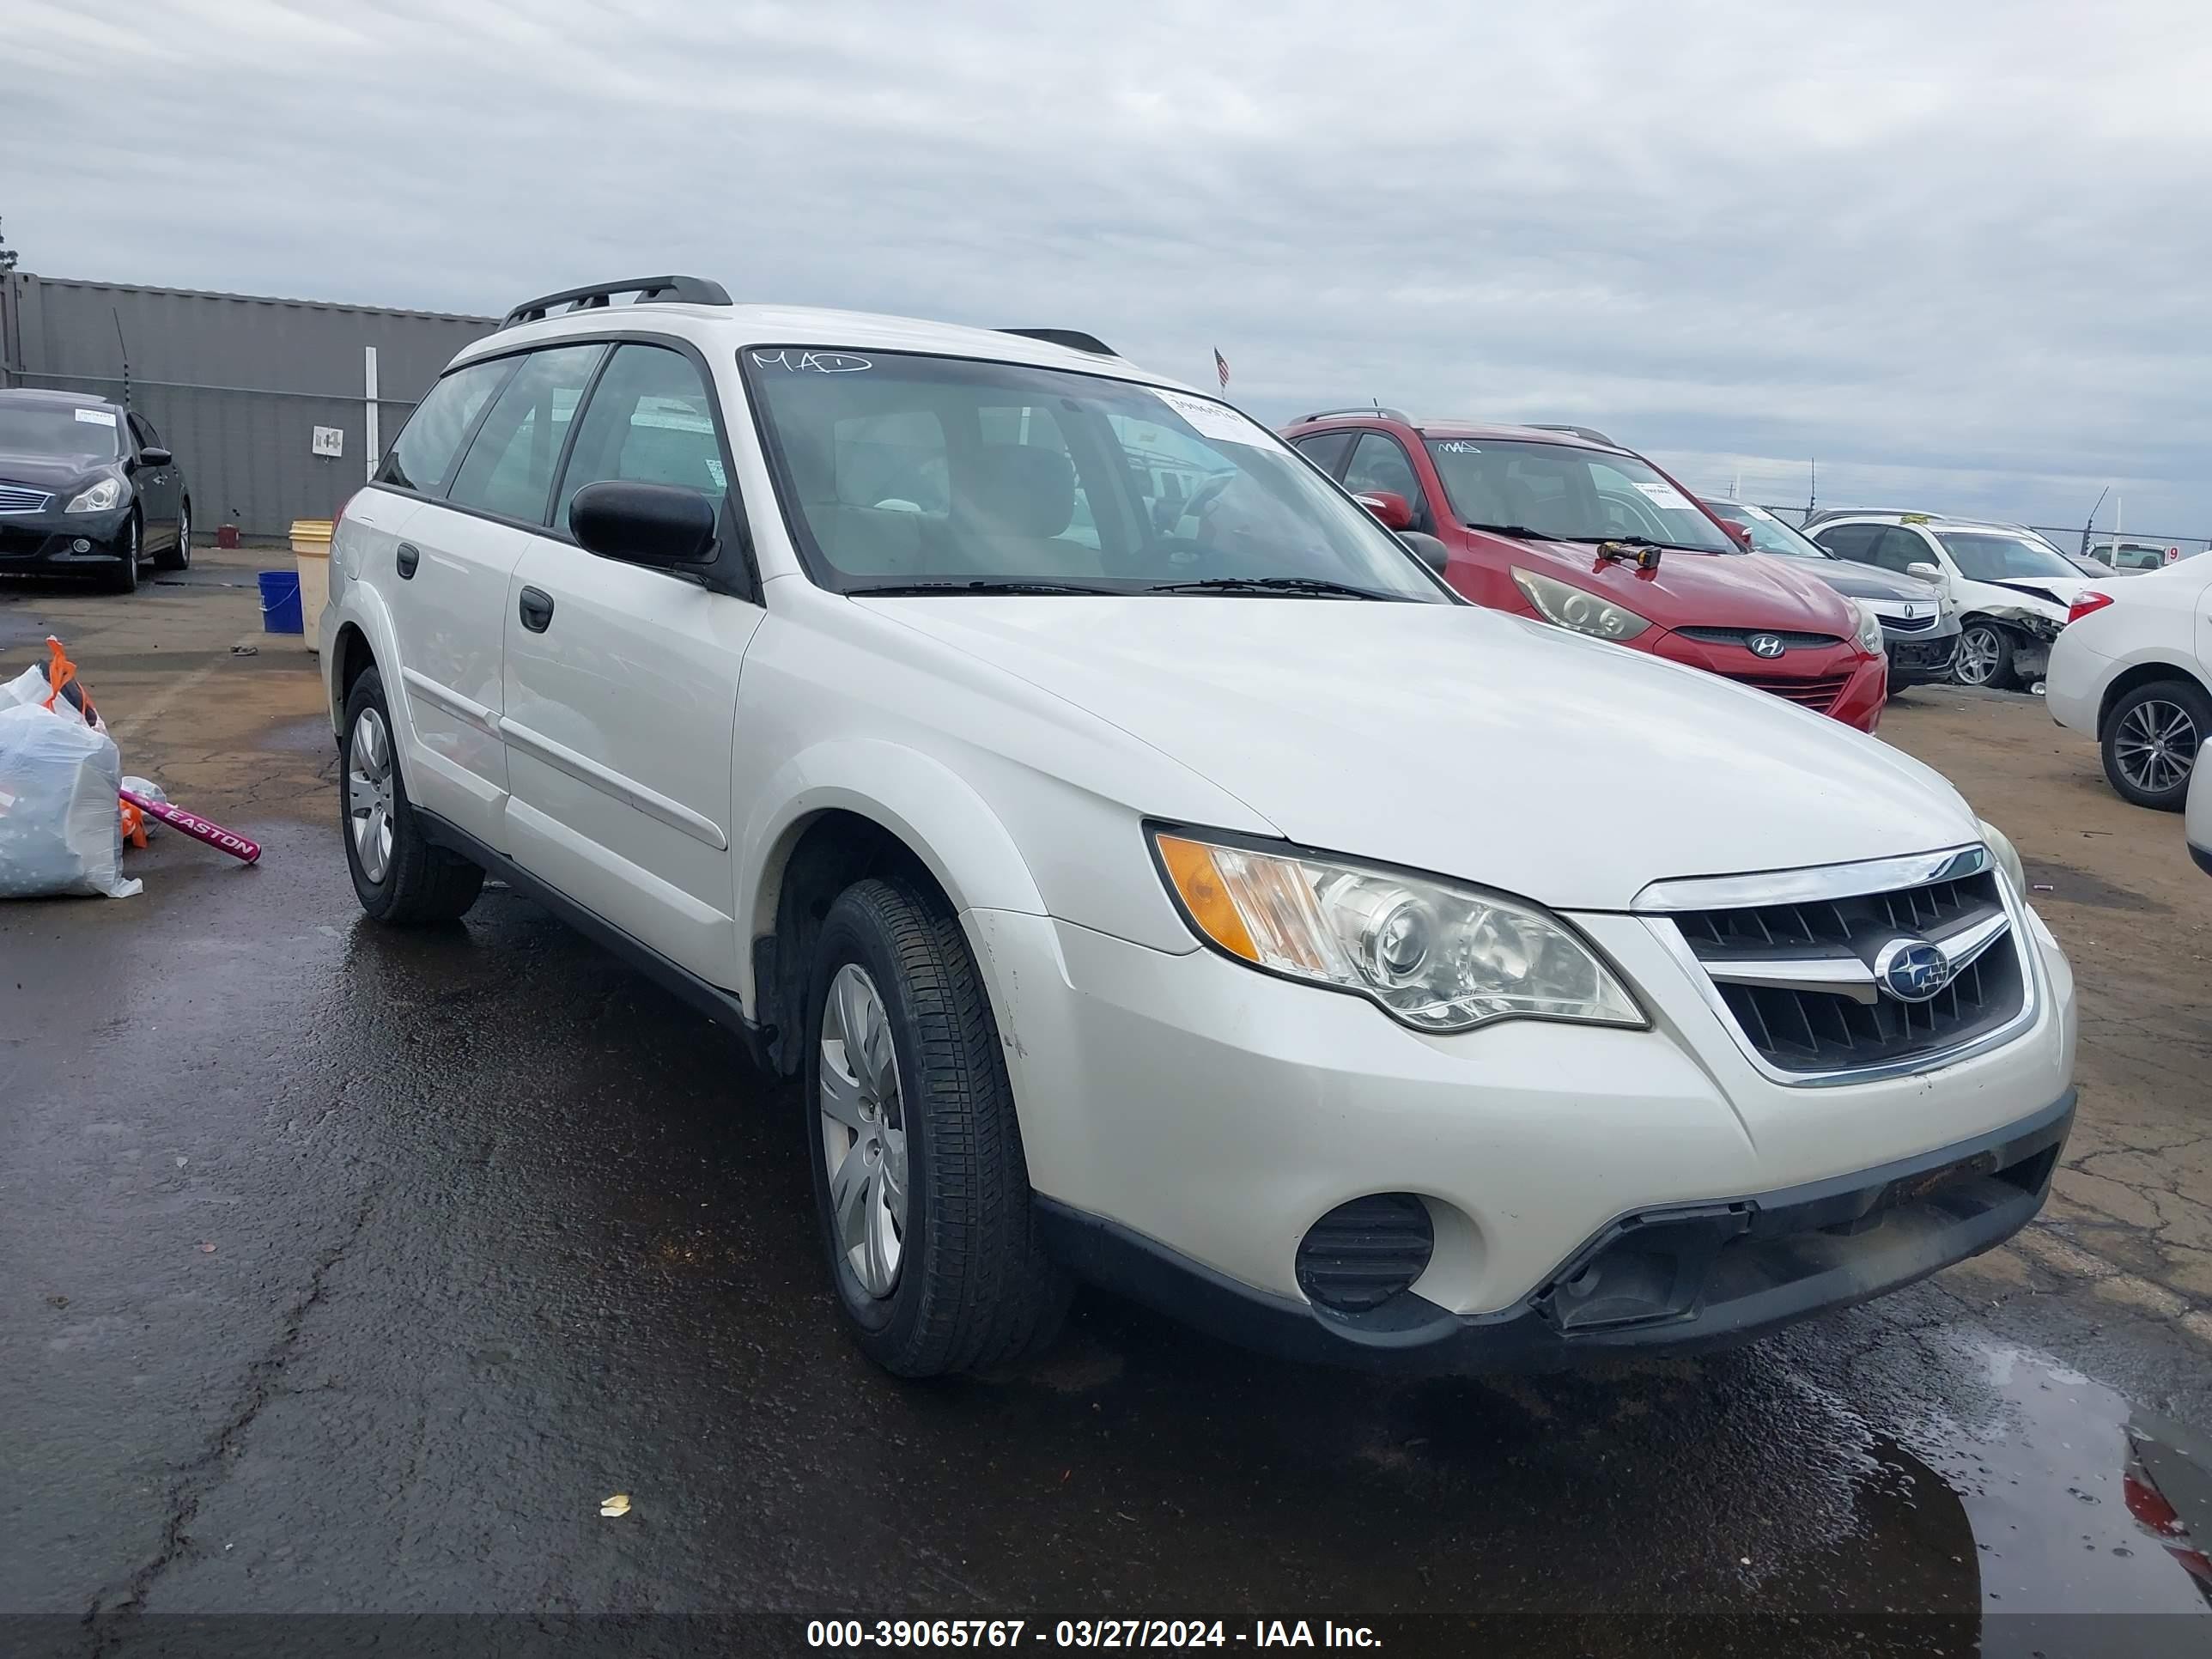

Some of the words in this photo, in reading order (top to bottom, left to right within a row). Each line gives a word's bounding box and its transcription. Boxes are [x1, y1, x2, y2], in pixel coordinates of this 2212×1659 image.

[752, 350, 872, 374] MAD
[2170, 547, 2178, 560] 9
[165, 810, 254, 854] EASTON
